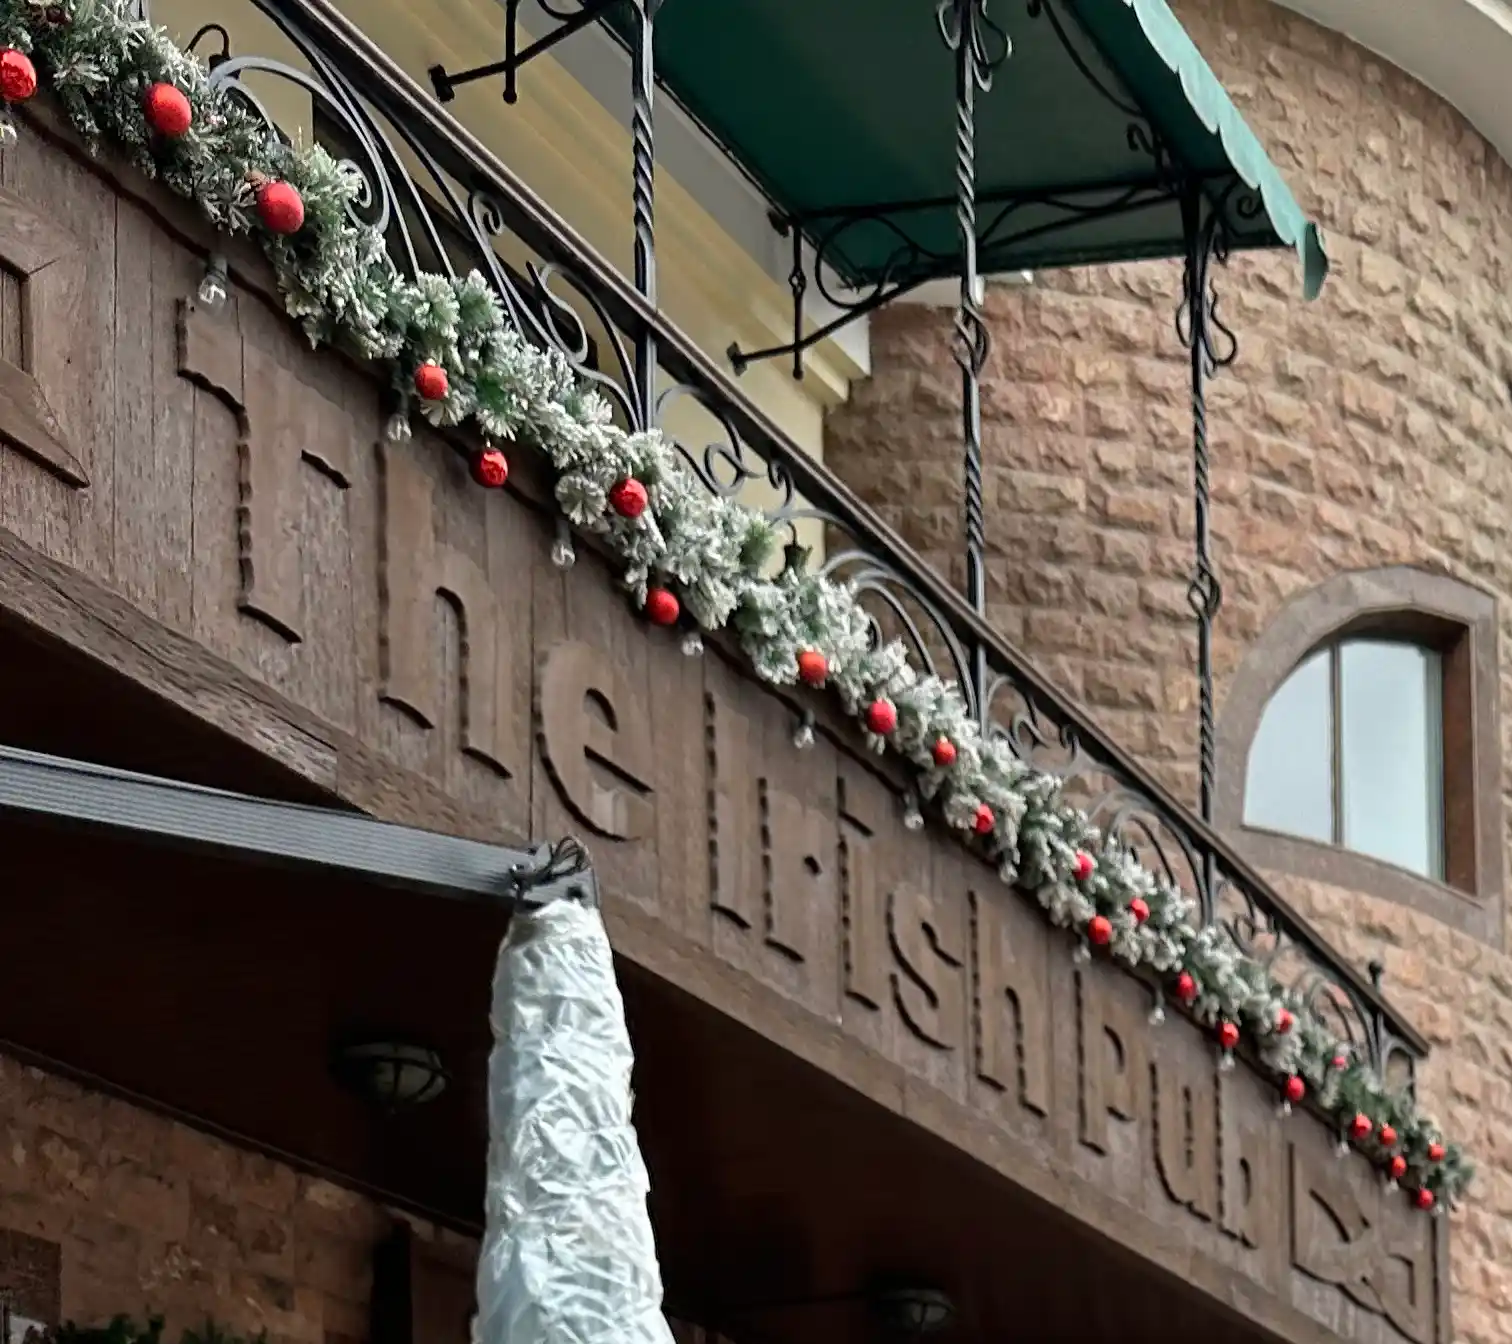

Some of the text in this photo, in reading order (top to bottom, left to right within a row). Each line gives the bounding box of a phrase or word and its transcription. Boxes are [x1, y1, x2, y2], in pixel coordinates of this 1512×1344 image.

[177, 292, 1268, 1252] The Irish Pub
